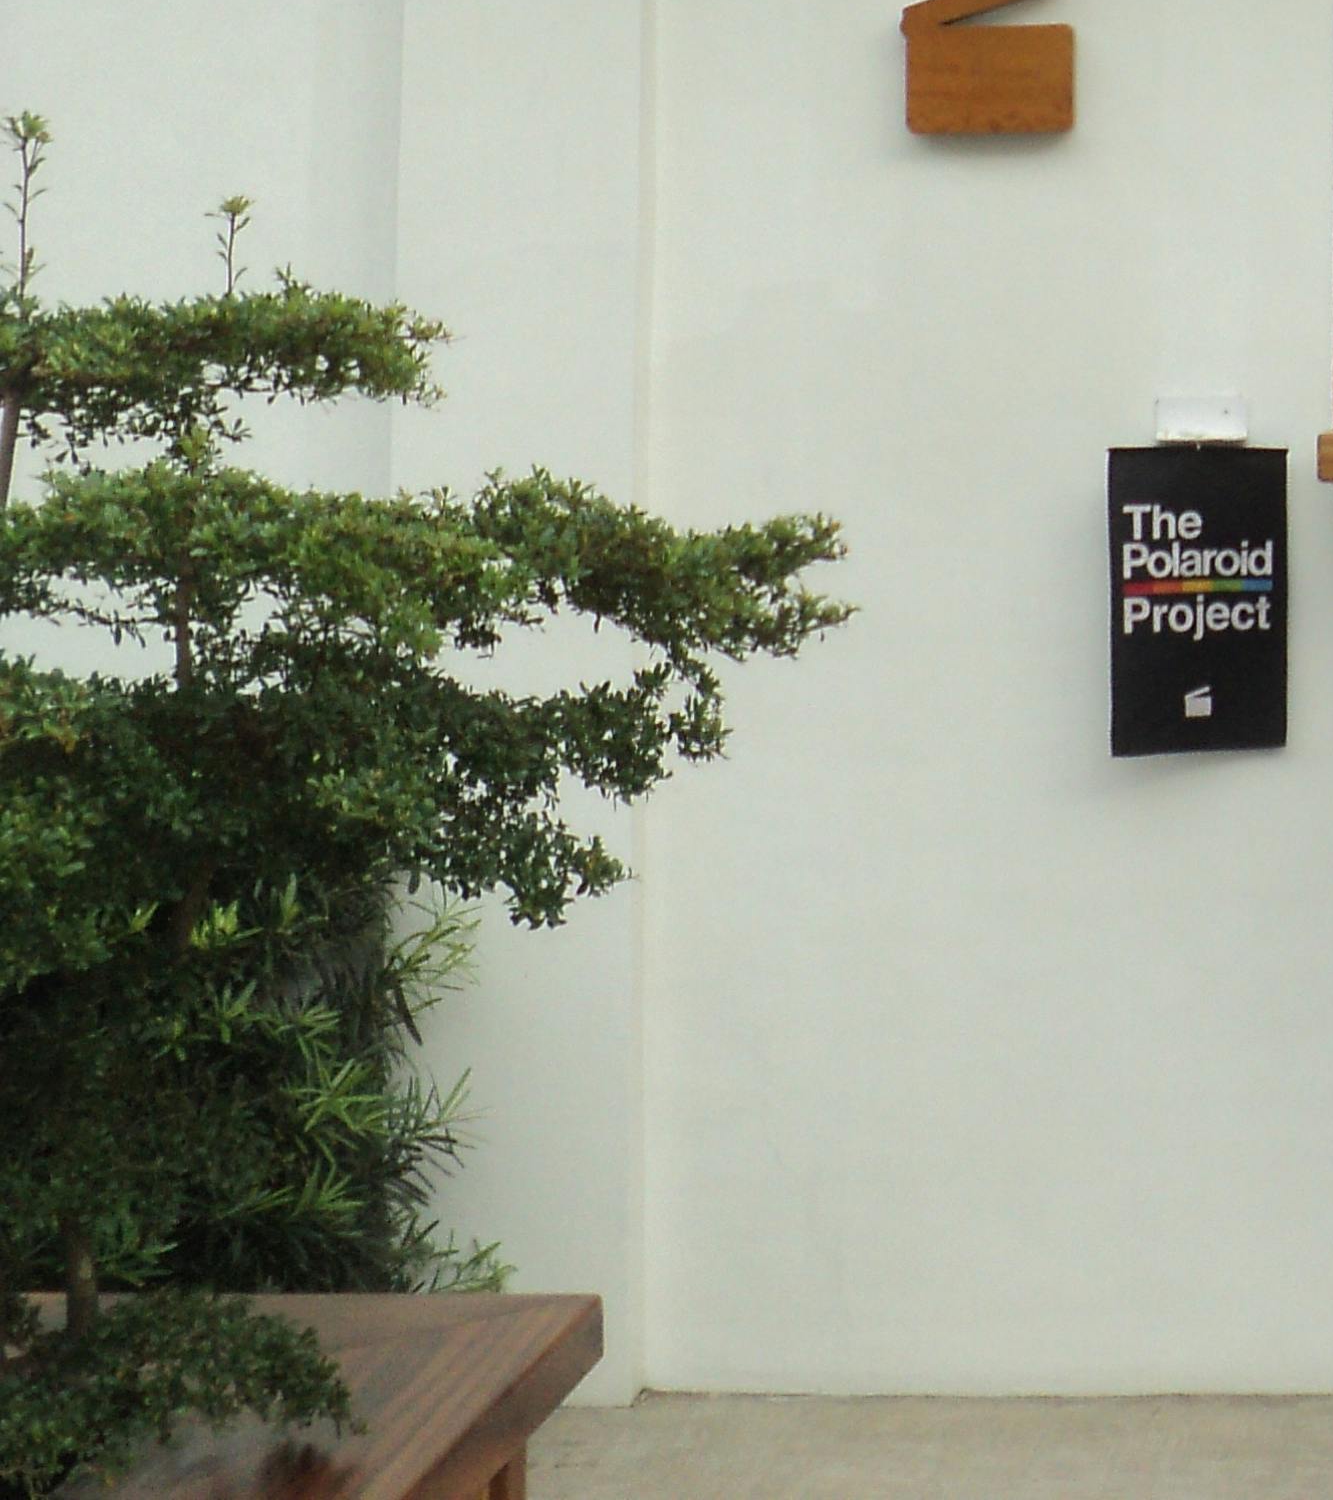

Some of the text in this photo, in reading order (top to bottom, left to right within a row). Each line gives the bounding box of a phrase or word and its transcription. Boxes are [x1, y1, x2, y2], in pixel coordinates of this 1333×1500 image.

[1122, 503, 1202, 540] The
[1122, 539, 1273, 580] Polaroid
[1123, 595, 1272, 642] Project
